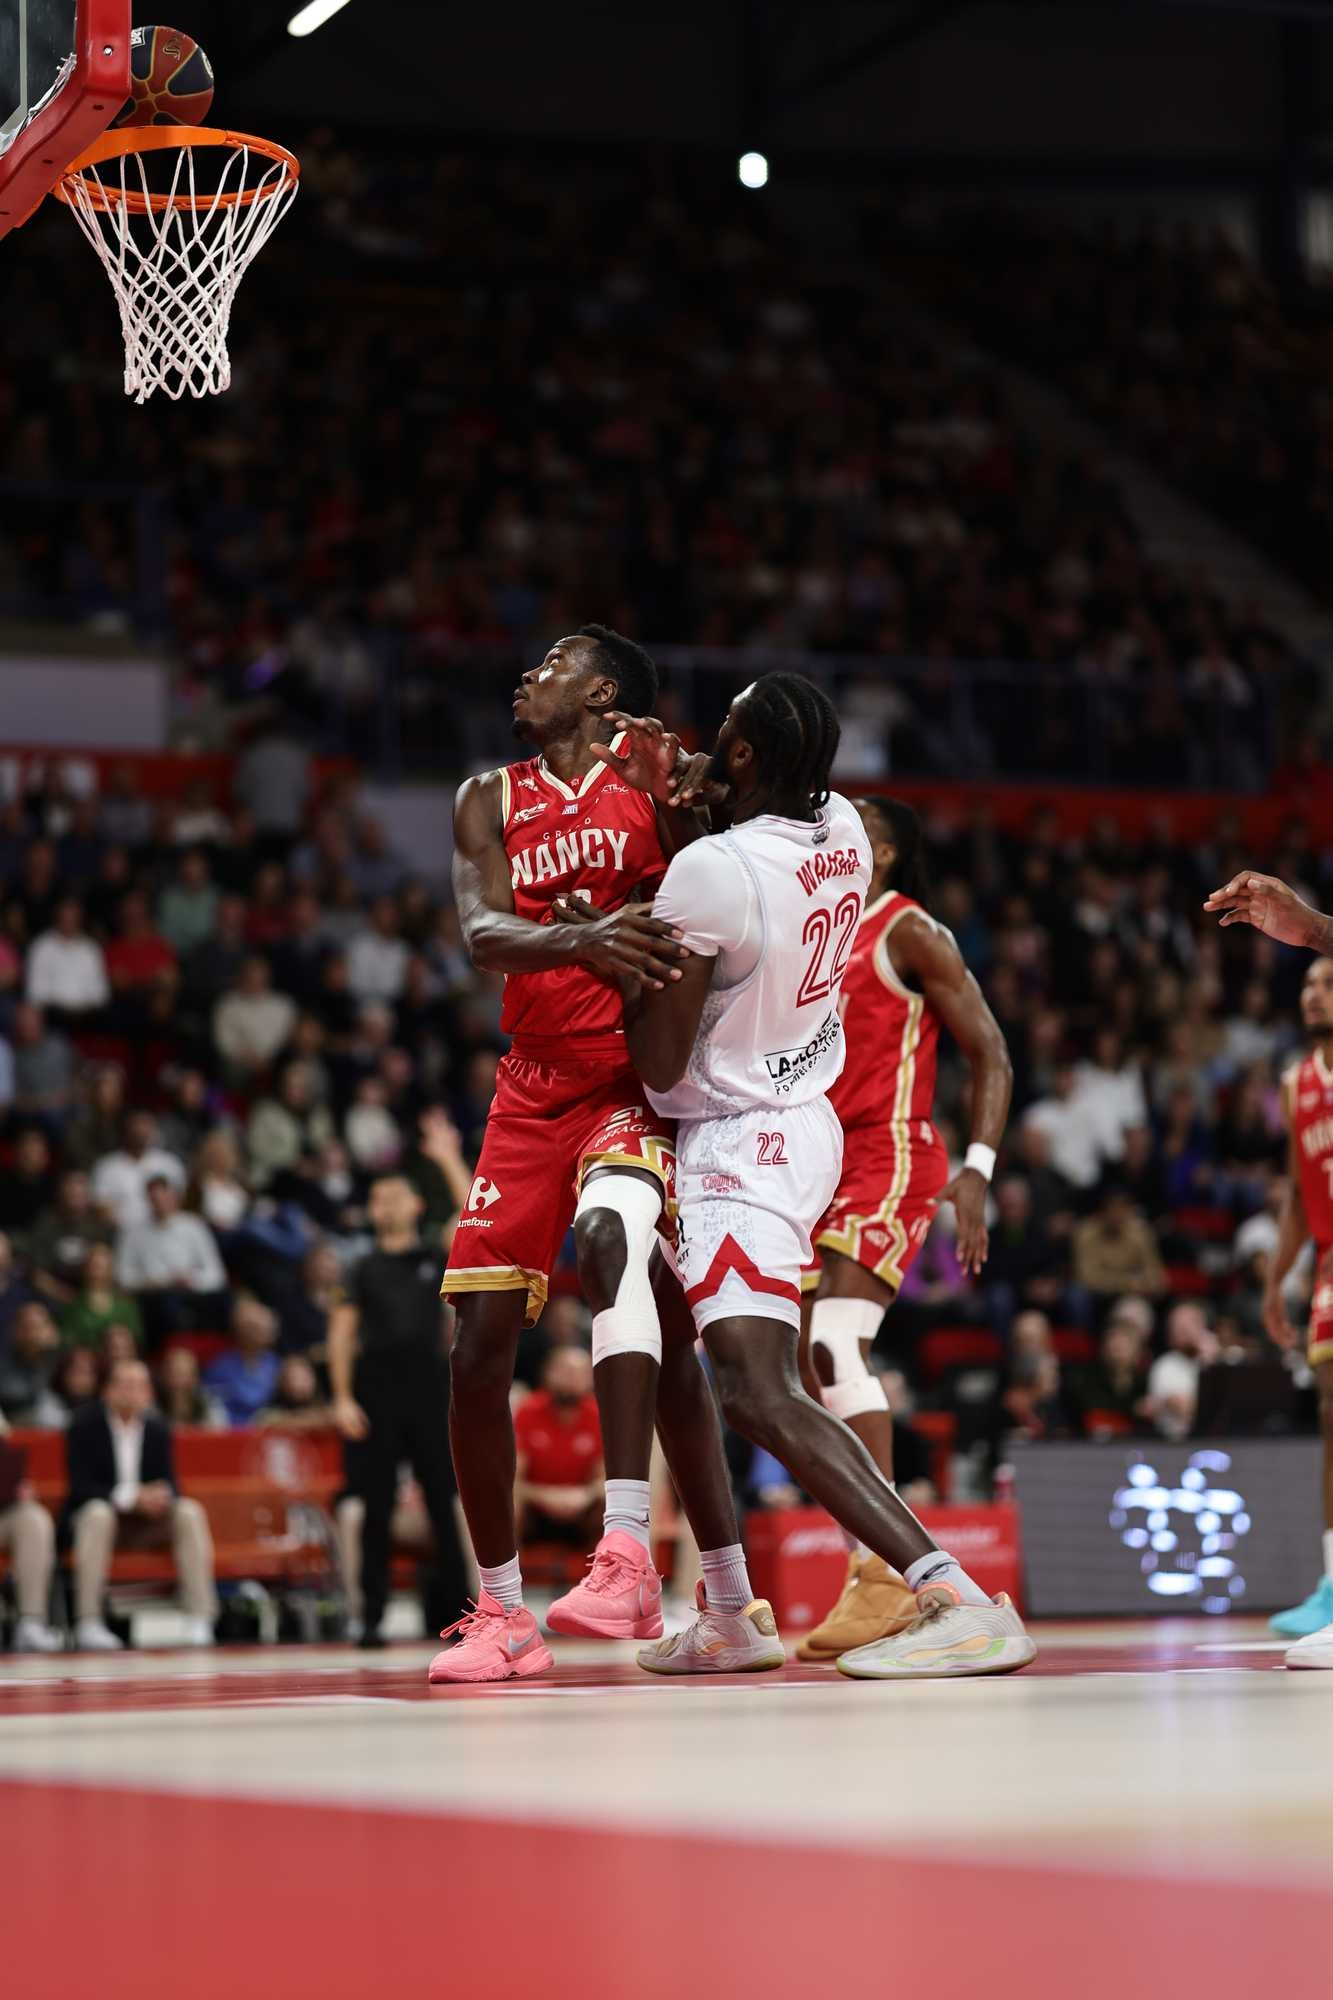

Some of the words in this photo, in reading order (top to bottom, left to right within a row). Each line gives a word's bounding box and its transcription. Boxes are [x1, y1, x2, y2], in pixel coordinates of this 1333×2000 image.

[511, 828, 631, 890] NANCY
[796, 891, 861, 1009] 22
[756, 1132, 789, 1166] 22
[456, 1217, 494, 1228] rrefour
